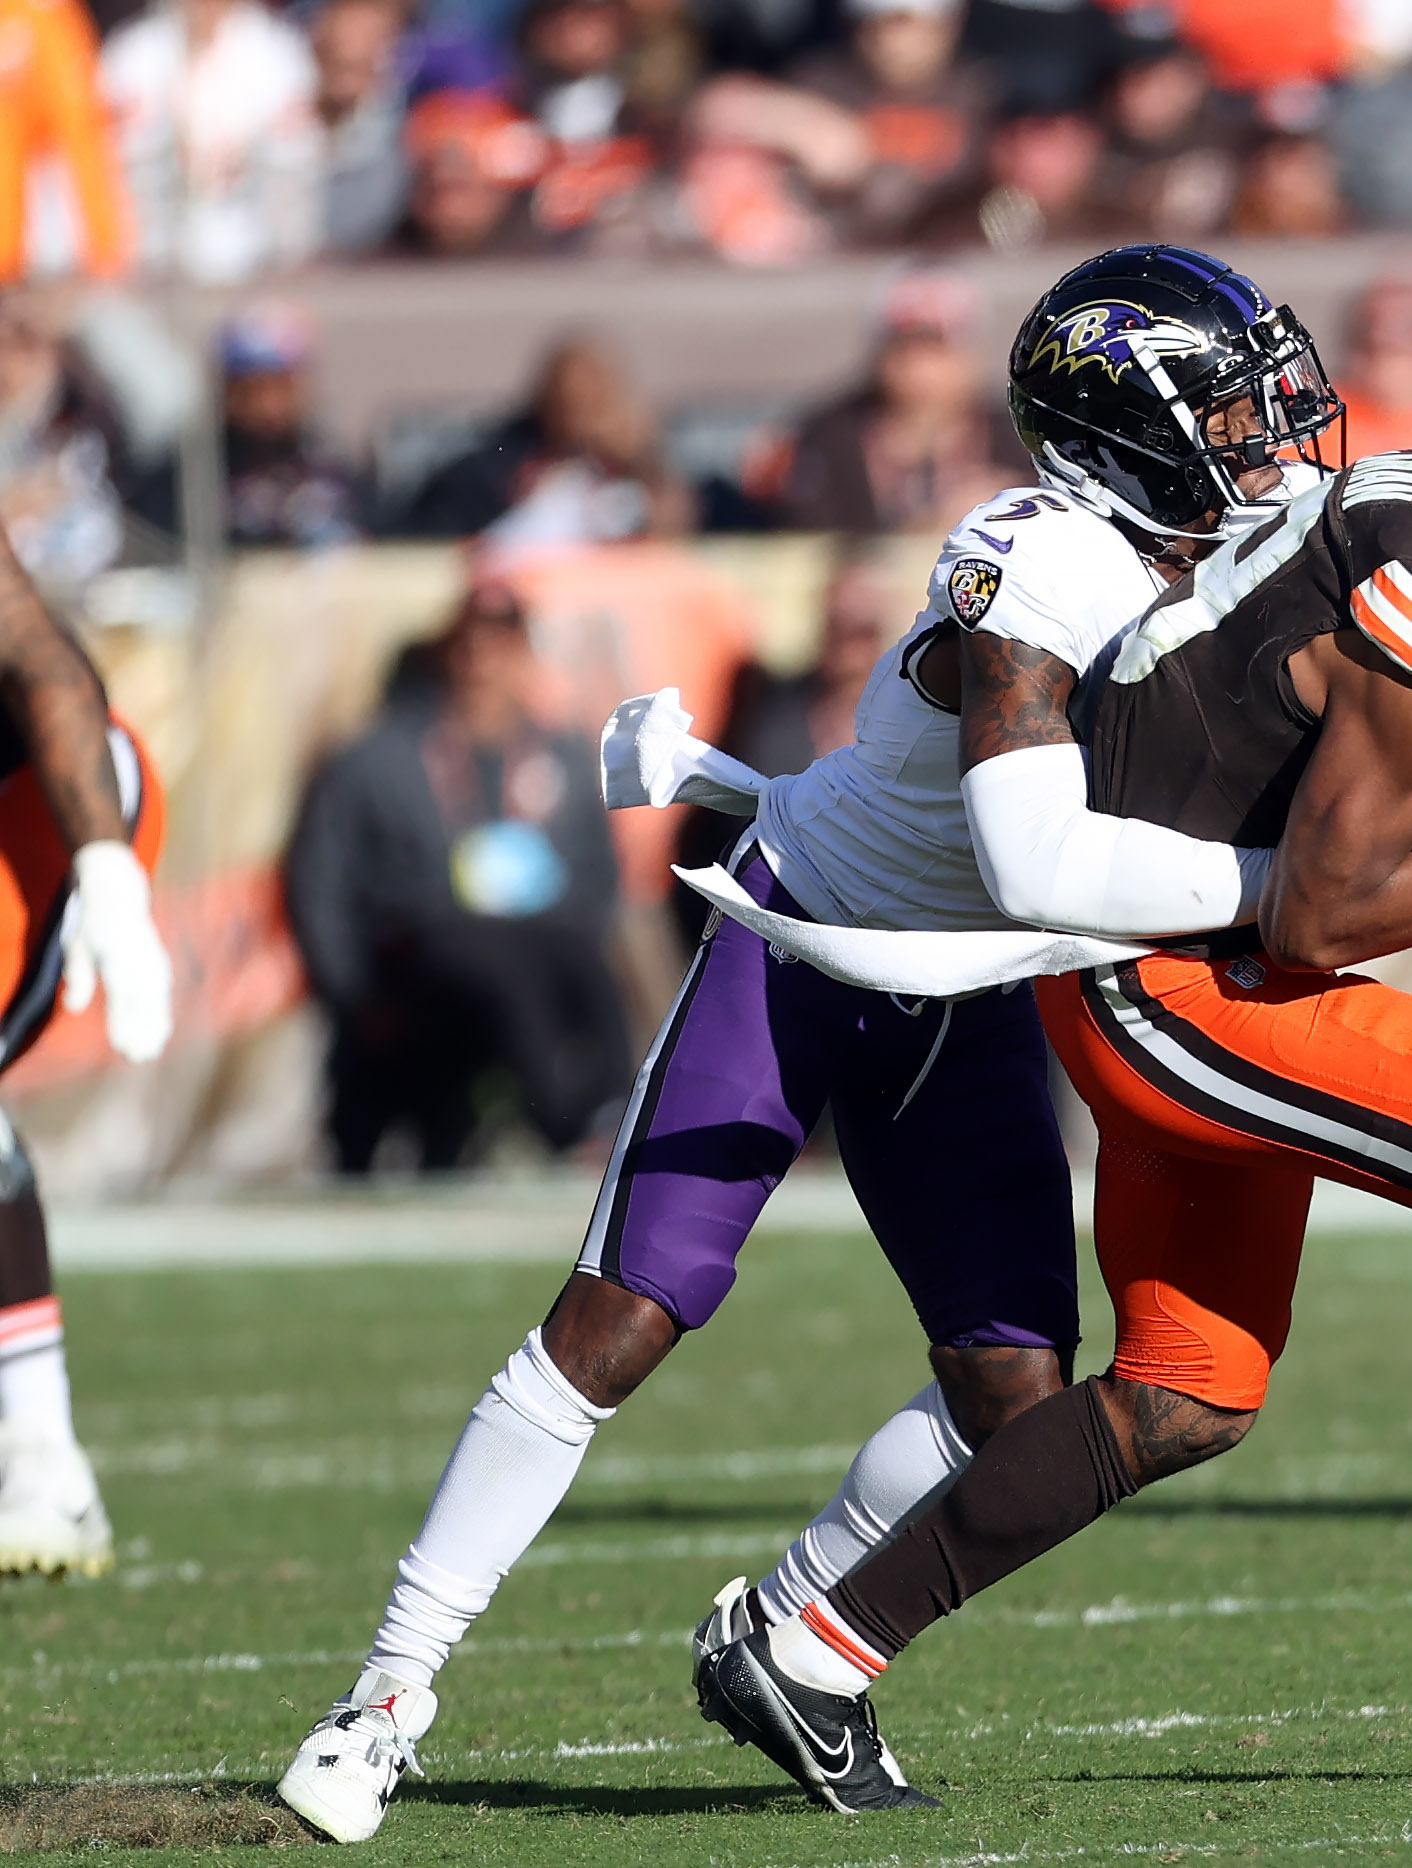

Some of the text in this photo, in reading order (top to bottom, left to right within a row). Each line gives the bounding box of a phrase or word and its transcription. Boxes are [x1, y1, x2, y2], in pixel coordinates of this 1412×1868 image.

[1056, 307, 1111, 355] B
[984, 492, 1069, 522] 5
[958, 561, 998, 576] RAVENS
